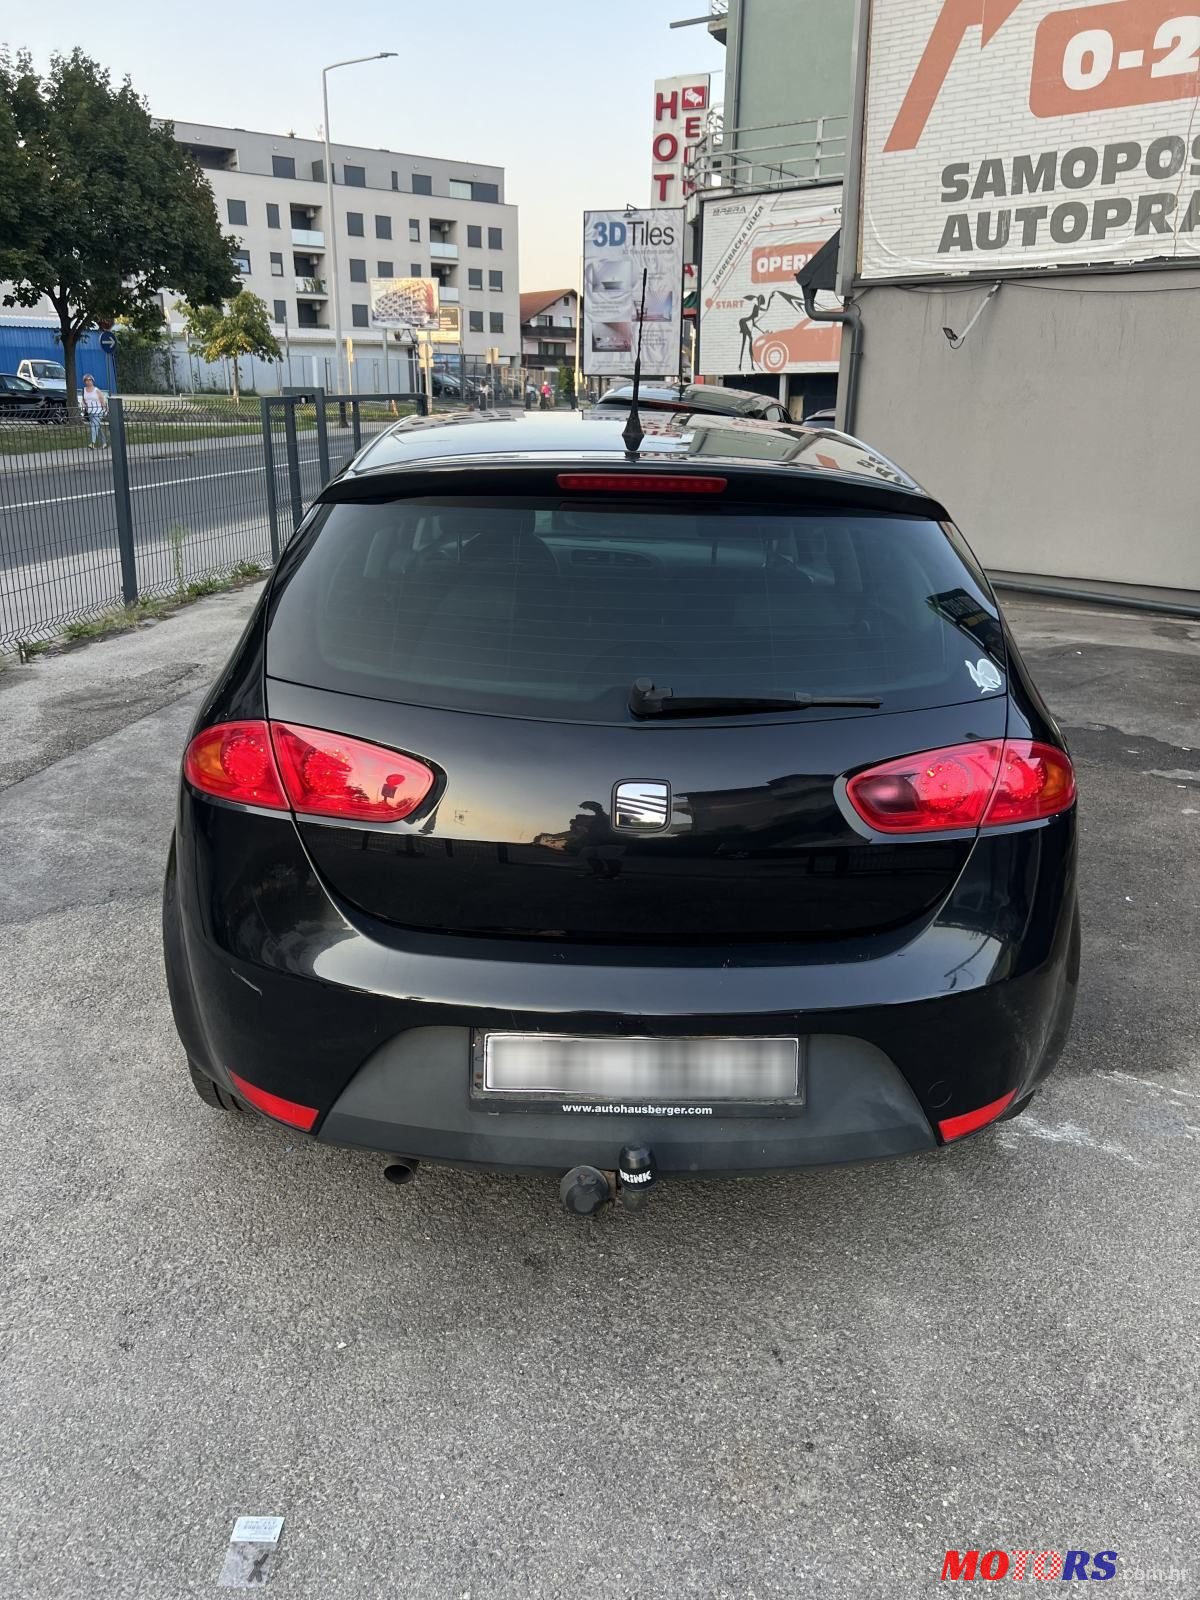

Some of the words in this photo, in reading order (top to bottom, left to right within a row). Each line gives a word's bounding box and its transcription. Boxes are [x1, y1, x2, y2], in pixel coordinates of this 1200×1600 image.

[746, 205, 764, 232] ULICA
[716, 300, 744, 309] START
[562, 1104, 713, 1116] www.autohausberger.com
